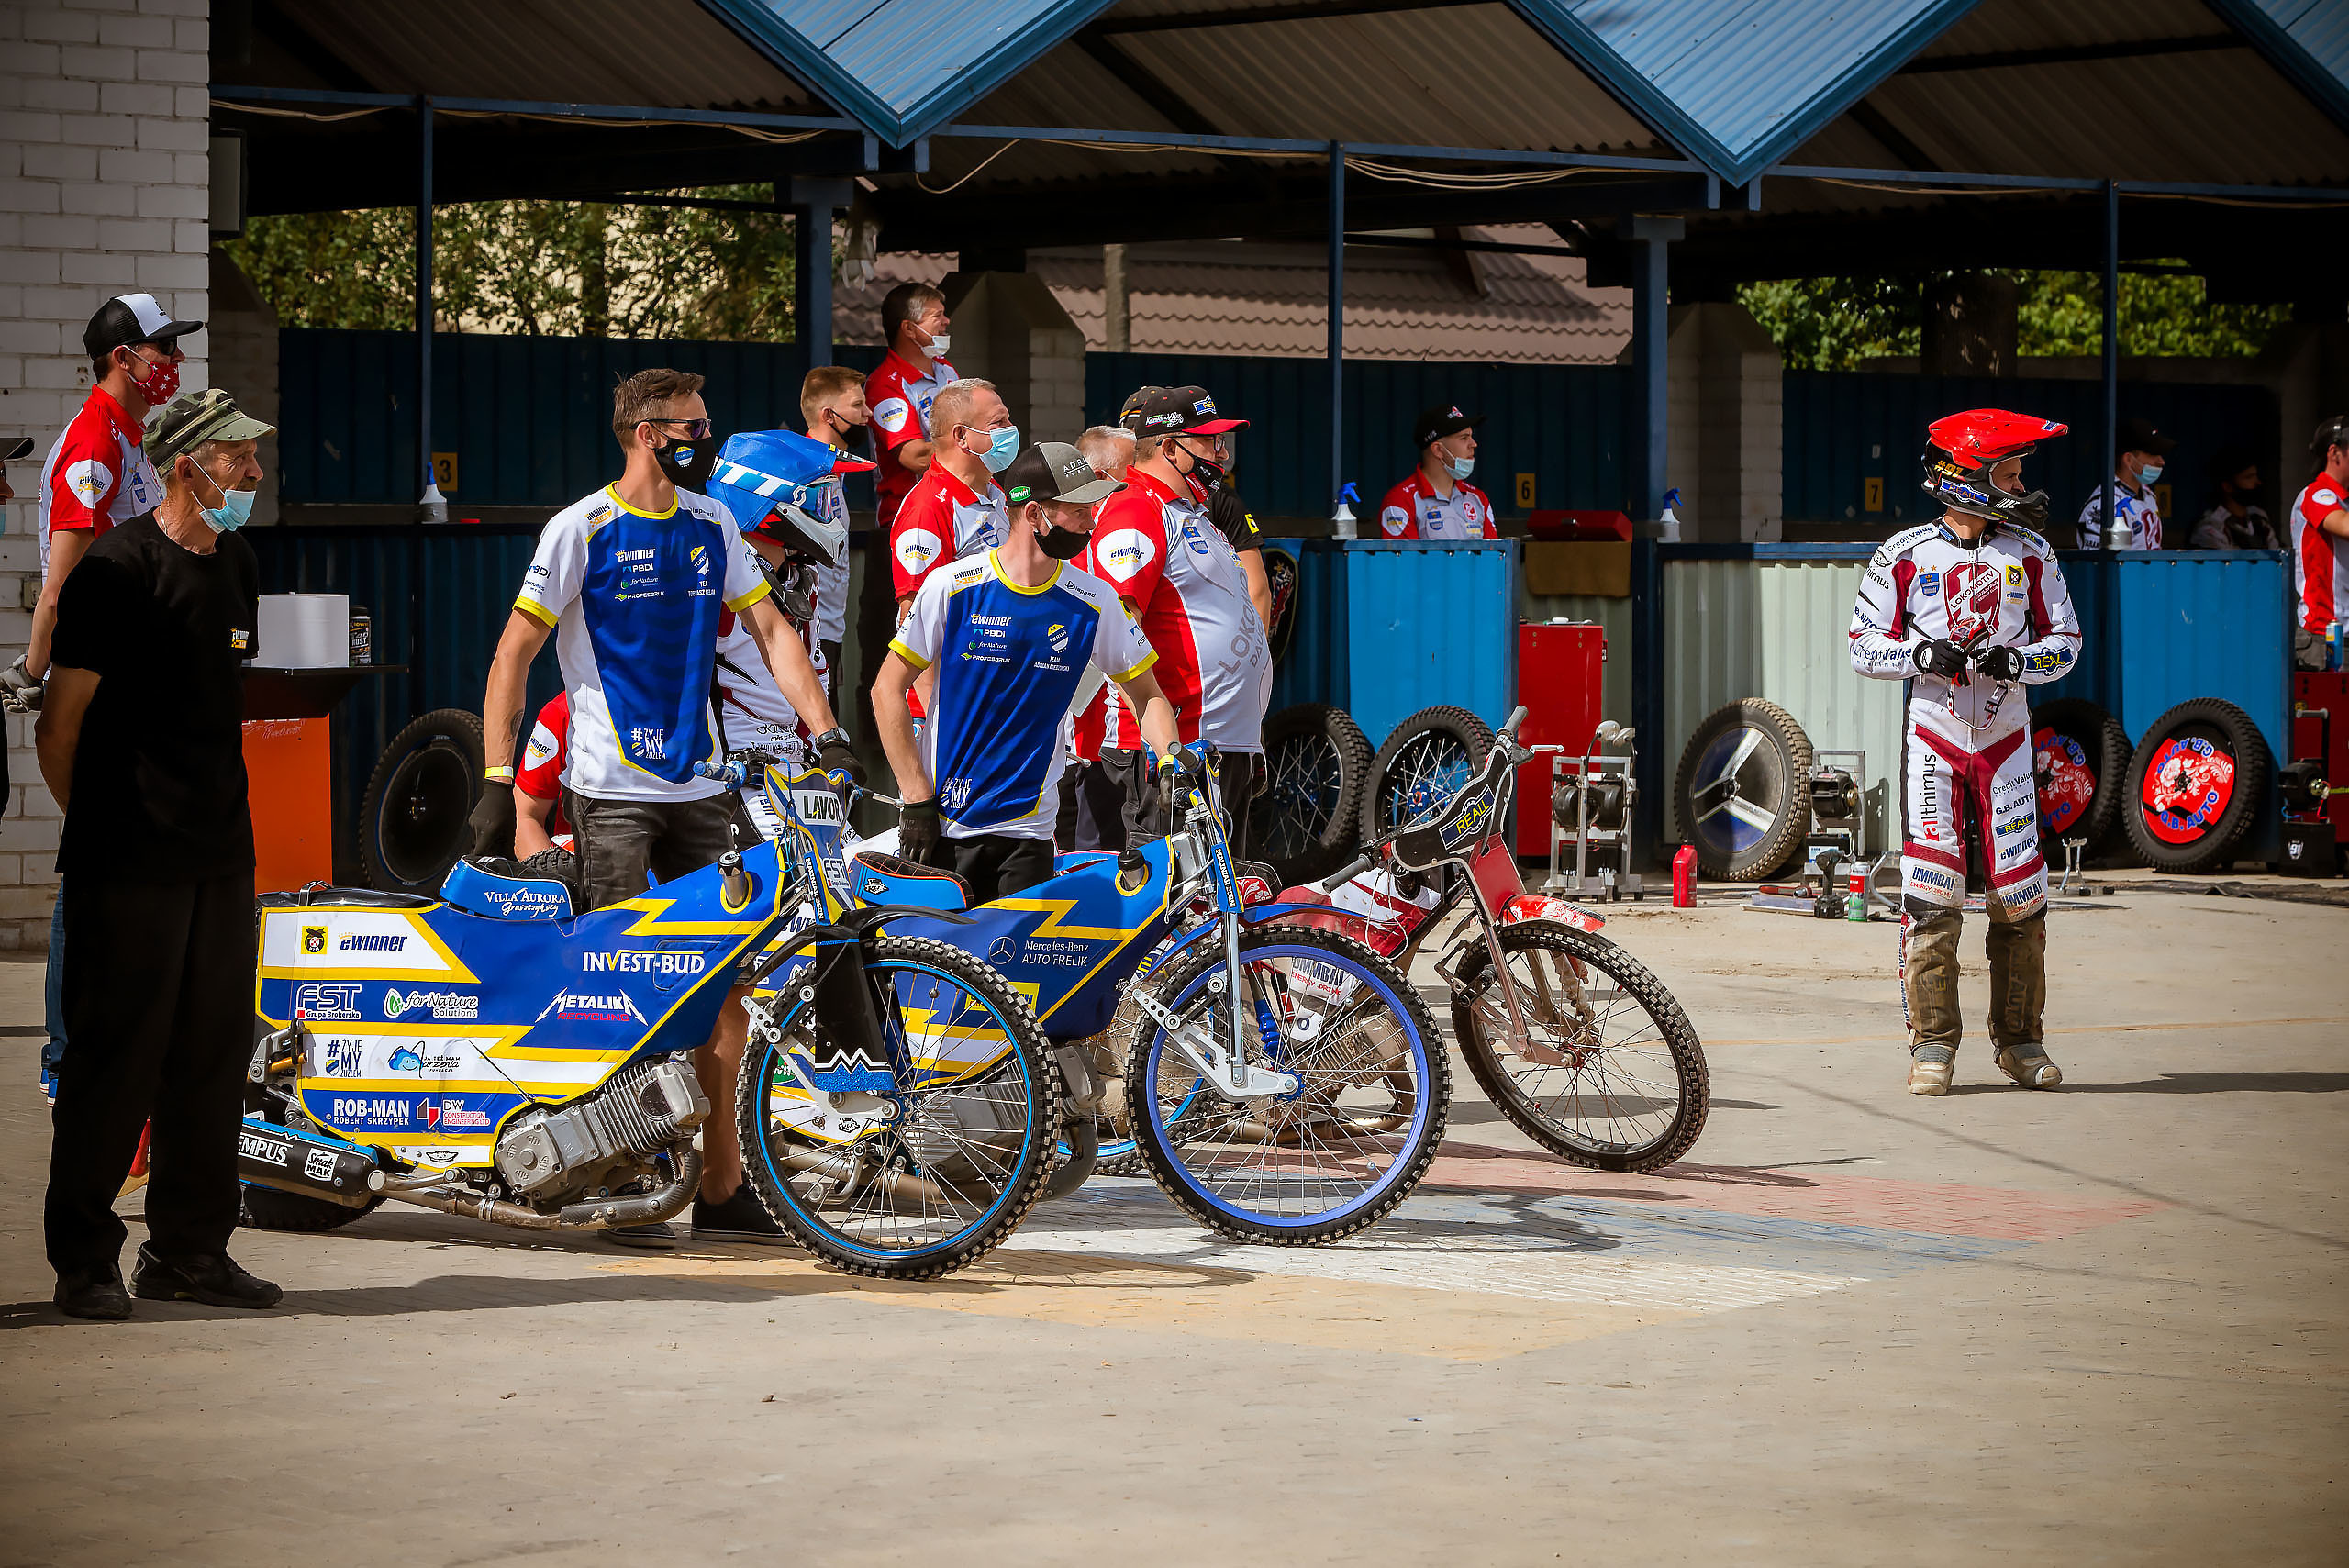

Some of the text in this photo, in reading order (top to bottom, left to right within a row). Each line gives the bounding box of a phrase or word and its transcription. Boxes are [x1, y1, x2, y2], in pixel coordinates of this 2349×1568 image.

[440, 459, 451, 484] 3
[1521, 480, 1531, 500] 6
[1869, 484, 1878, 503] 7
[618, 548, 656, 562] eWinner
[632, 563, 654, 573] PBDI
[1950, 570, 1995, 609] LOKOMOTIV
[971, 615, 1011, 626] eWinner
[983, 629, 1005, 638] PBDI
[645, 739, 663, 754] MY
[1993, 771, 2033, 795] Credit Value
[952, 788, 971, 805] MY
[1996, 792, 2034, 815] G.B. AUTO
[1456, 800, 1489, 834] REALL
[2186, 790, 2220, 829] AUTO
[2005, 818, 2031, 833] REALL
[2000, 836, 2037, 860] eWinner
[522, 888, 566, 904] AURORA
[340, 934, 407, 951] eWinner
[1025, 940, 1089, 952] Mercedes-Benz
[582, 951, 705, 973] INVEST-BUD
[1022, 953, 1087, 967] AUTO FRELIK
[1292, 973, 1315, 986] ENERGY
[297, 984, 362, 1010] FST
[406, 993, 478, 1009] forNature
[306, 1011, 326, 1019] Grupa
[434, 1009, 477, 1018] Solutions
[558, 1013, 629, 1021] RECYCLING
[342, 1052, 362, 1071] MY
[333, 1099, 409, 1117] ROB-MAN
[443, 1100, 464, 1111] DW
[367, 1117, 409, 1125] SKRZYPEK
[308, 1153, 333, 1168] Smak
[307, 1163, 330, 1177] MAK
